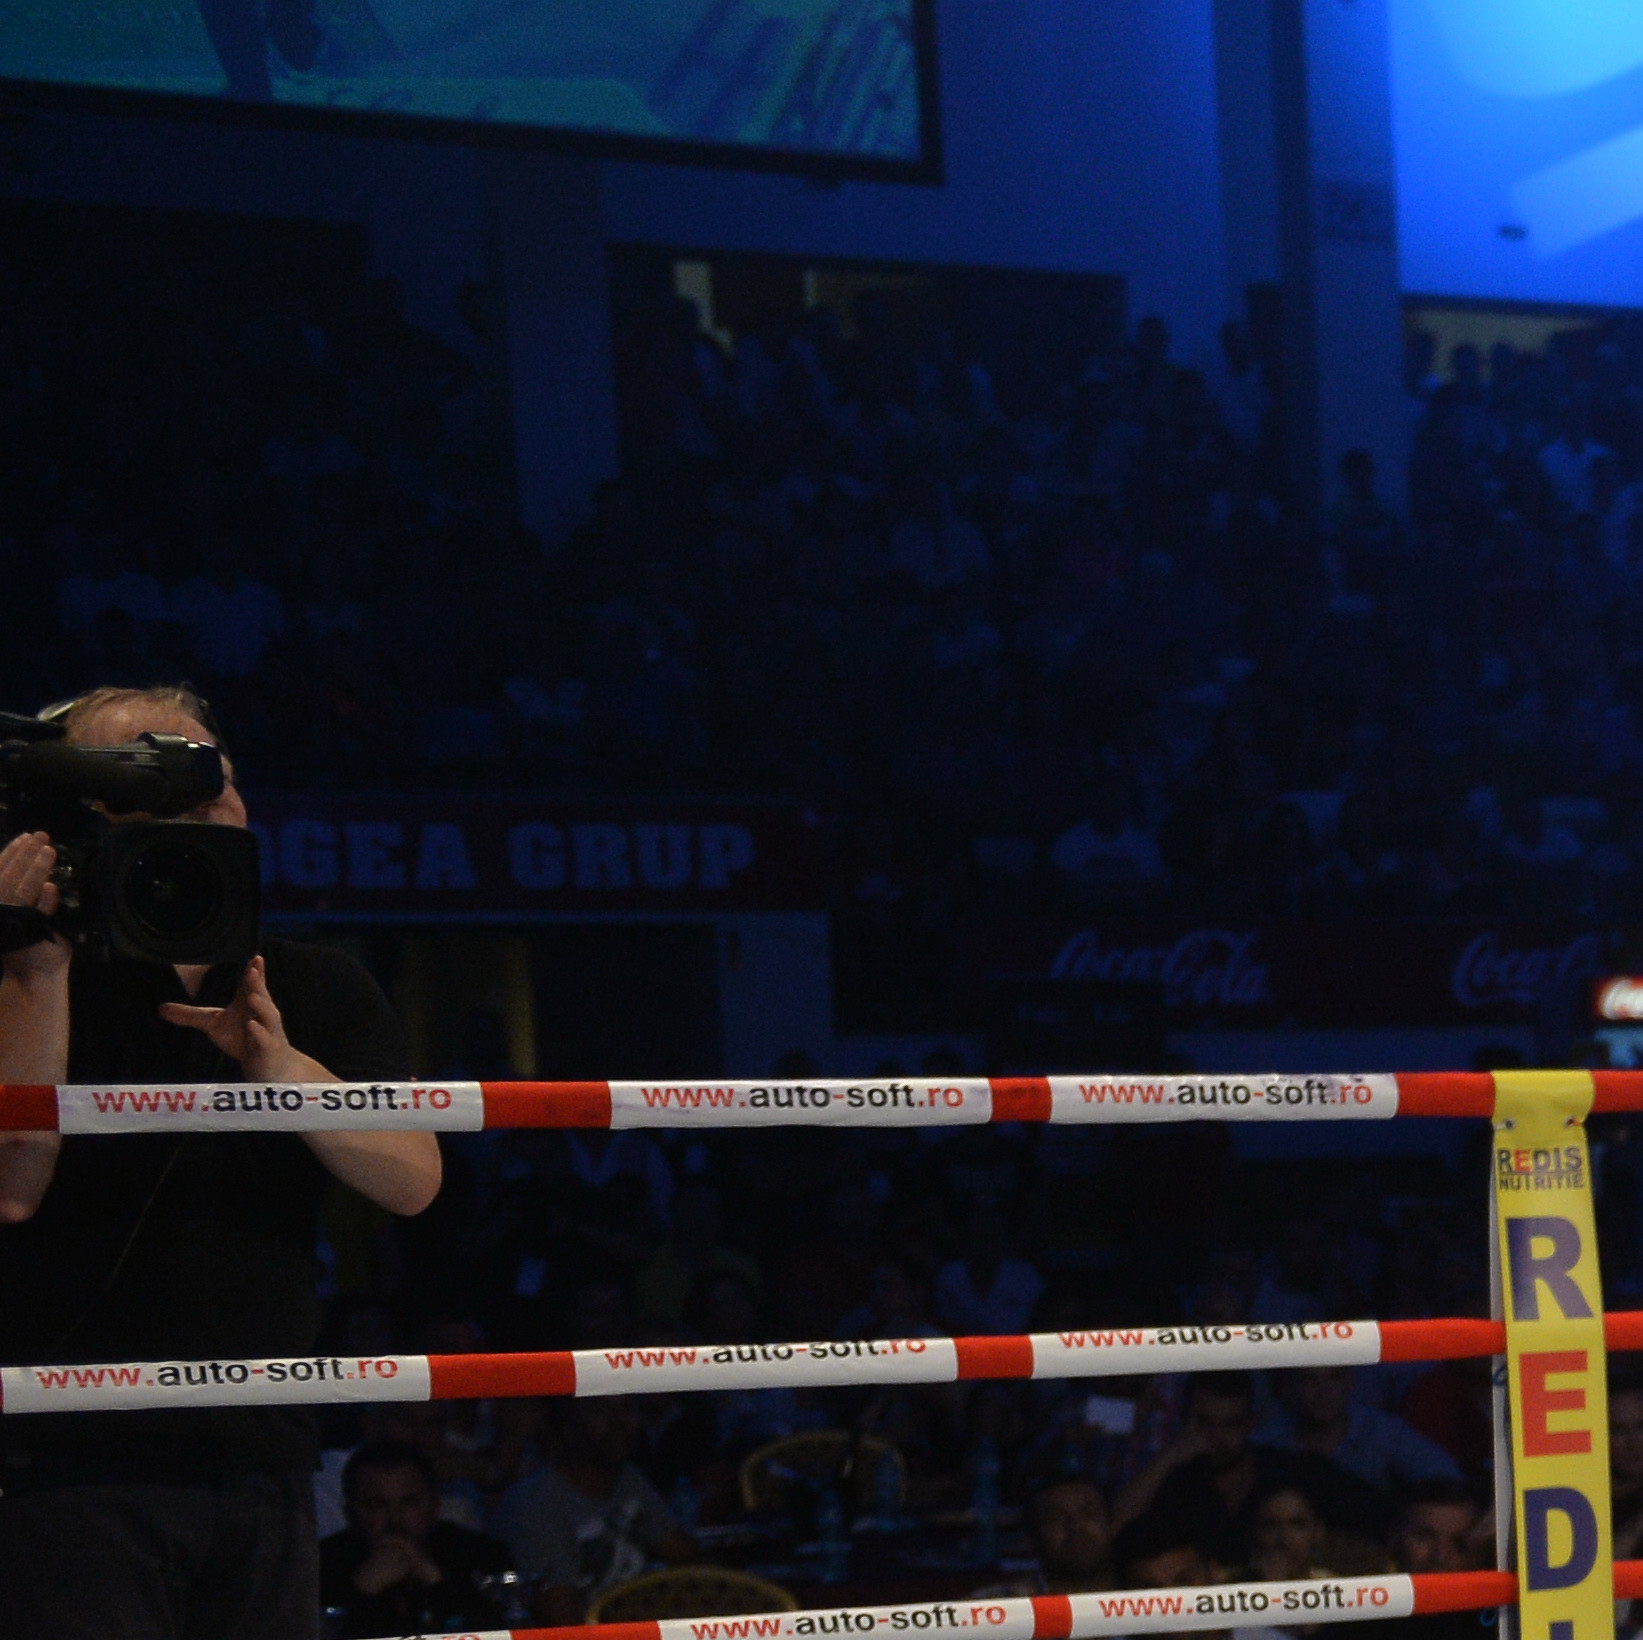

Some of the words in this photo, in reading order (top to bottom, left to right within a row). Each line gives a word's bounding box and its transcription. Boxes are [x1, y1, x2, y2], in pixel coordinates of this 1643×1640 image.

[508, 822, 756, 890] GRUP
[93, 1083, 452, 1114] www.auto-soft.ro
[641, 1081, 964, 1112] www.auto-soft.ro
[1079, 1078, 1373, 1109] www.auto-soft.ro
[1498, 1147, 1583, 1172] REDIS
[36, 1354, 399, 1390] www.auto-soft.ro
[1098, 1579, 1389, 1620] www.auto-soft.ro
